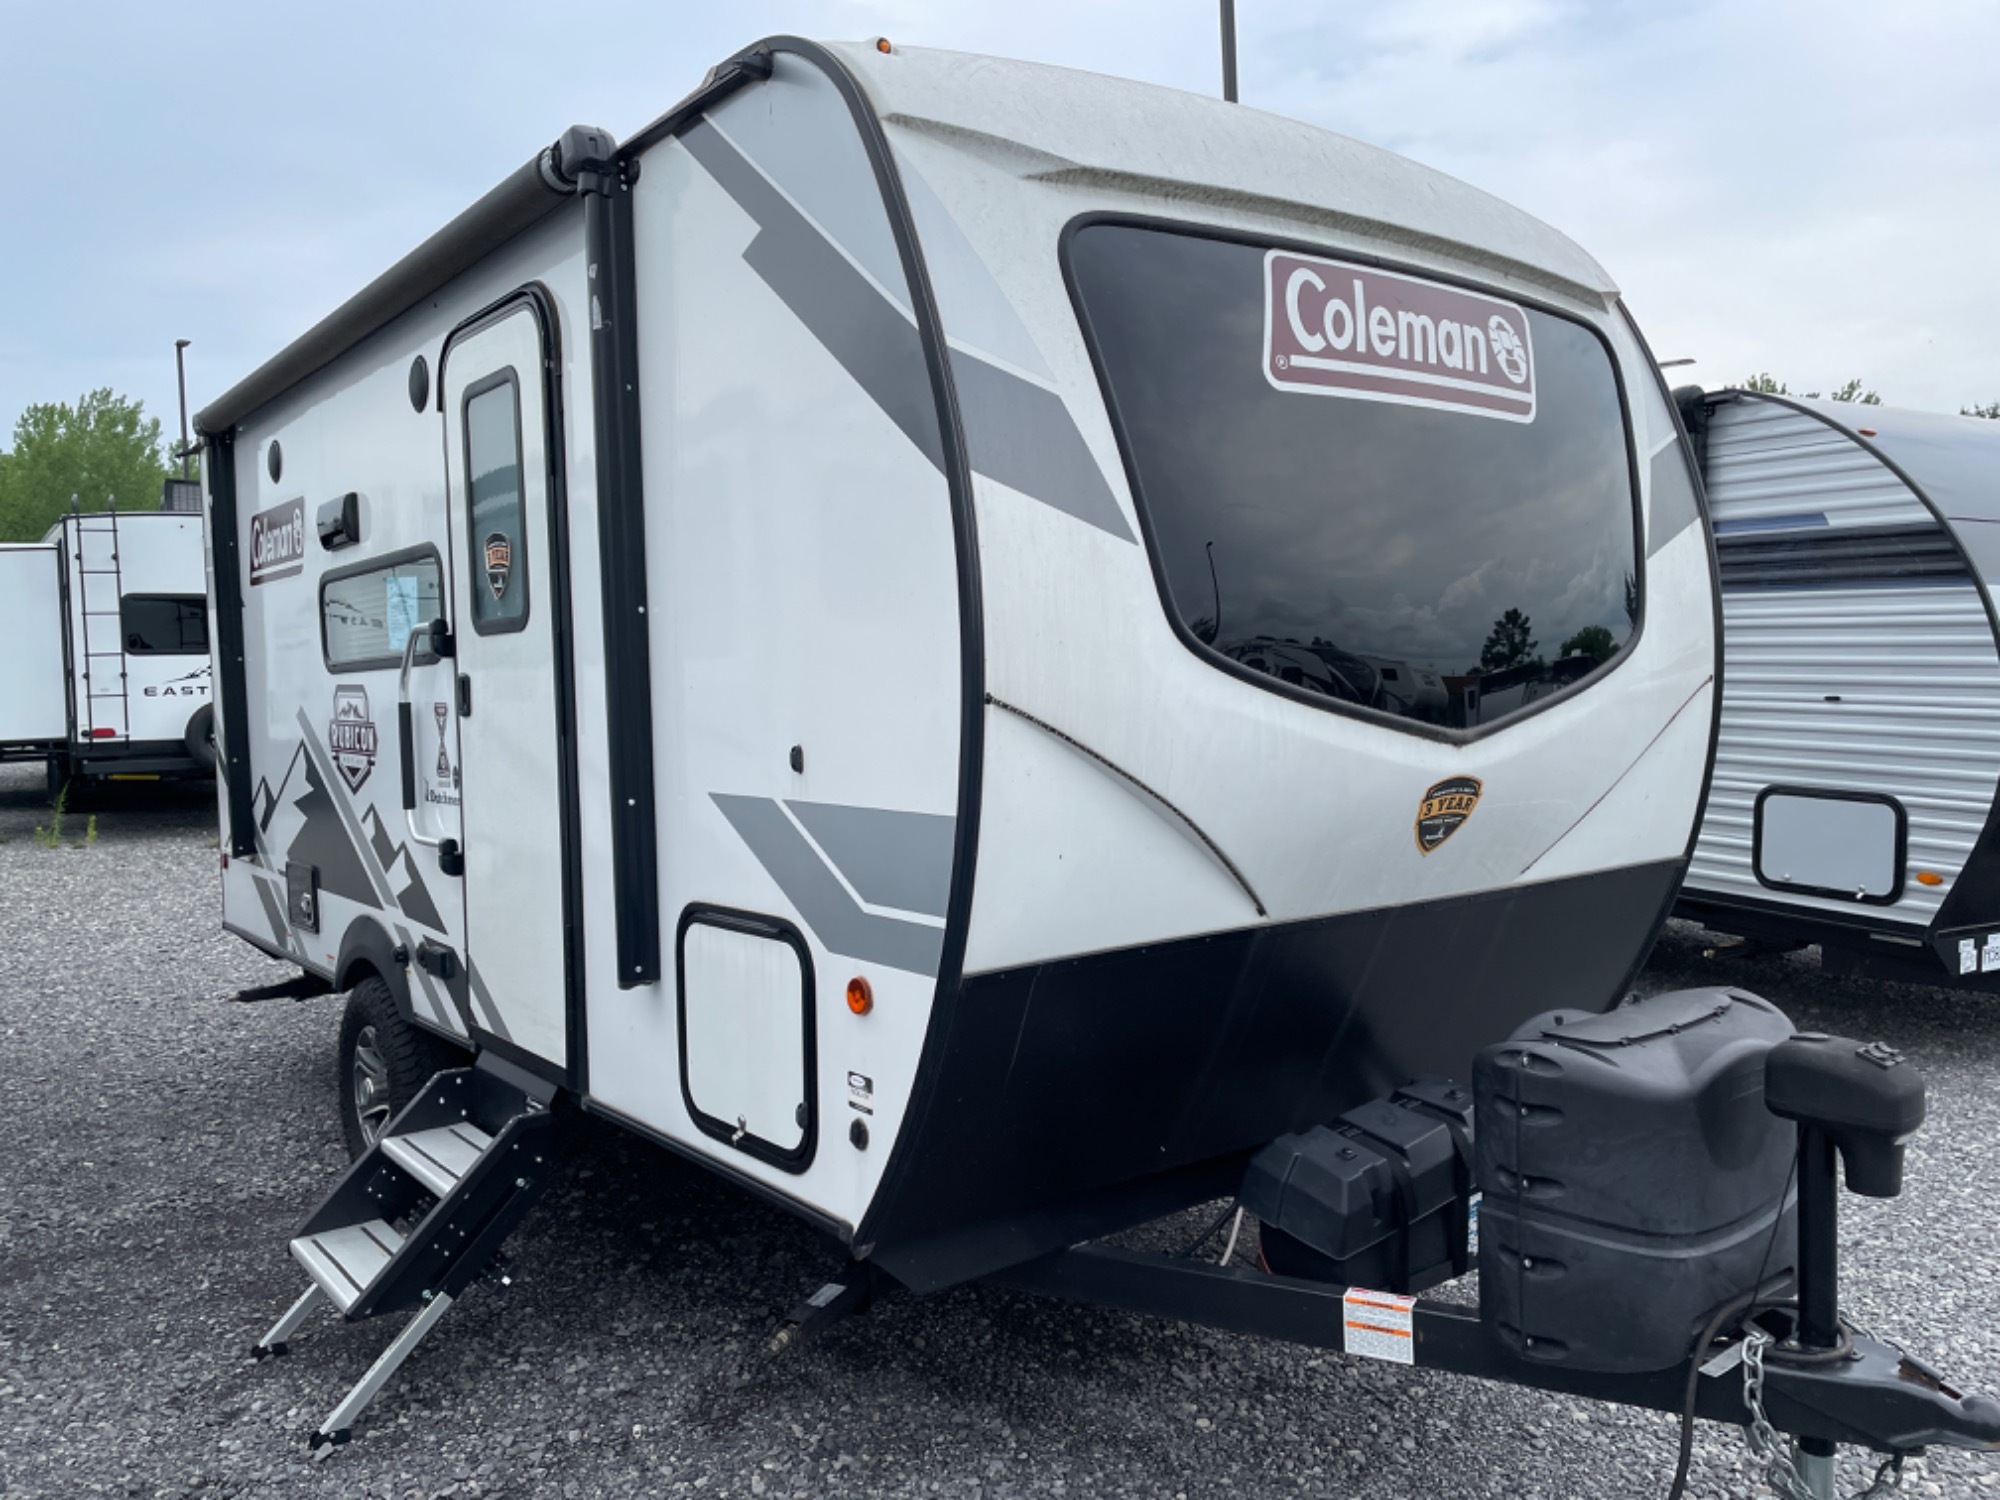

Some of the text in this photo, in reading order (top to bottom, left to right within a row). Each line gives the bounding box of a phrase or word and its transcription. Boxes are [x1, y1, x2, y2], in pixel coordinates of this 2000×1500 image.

[1285, 267, 1489, 374] Coleman
[252, 517, 293, 569] Coleman
[143, 686, 209, 697] EAST
[331, 723, 376, 753] RUBICON
[1423, 796, 1474, 816] 3 YEAR
